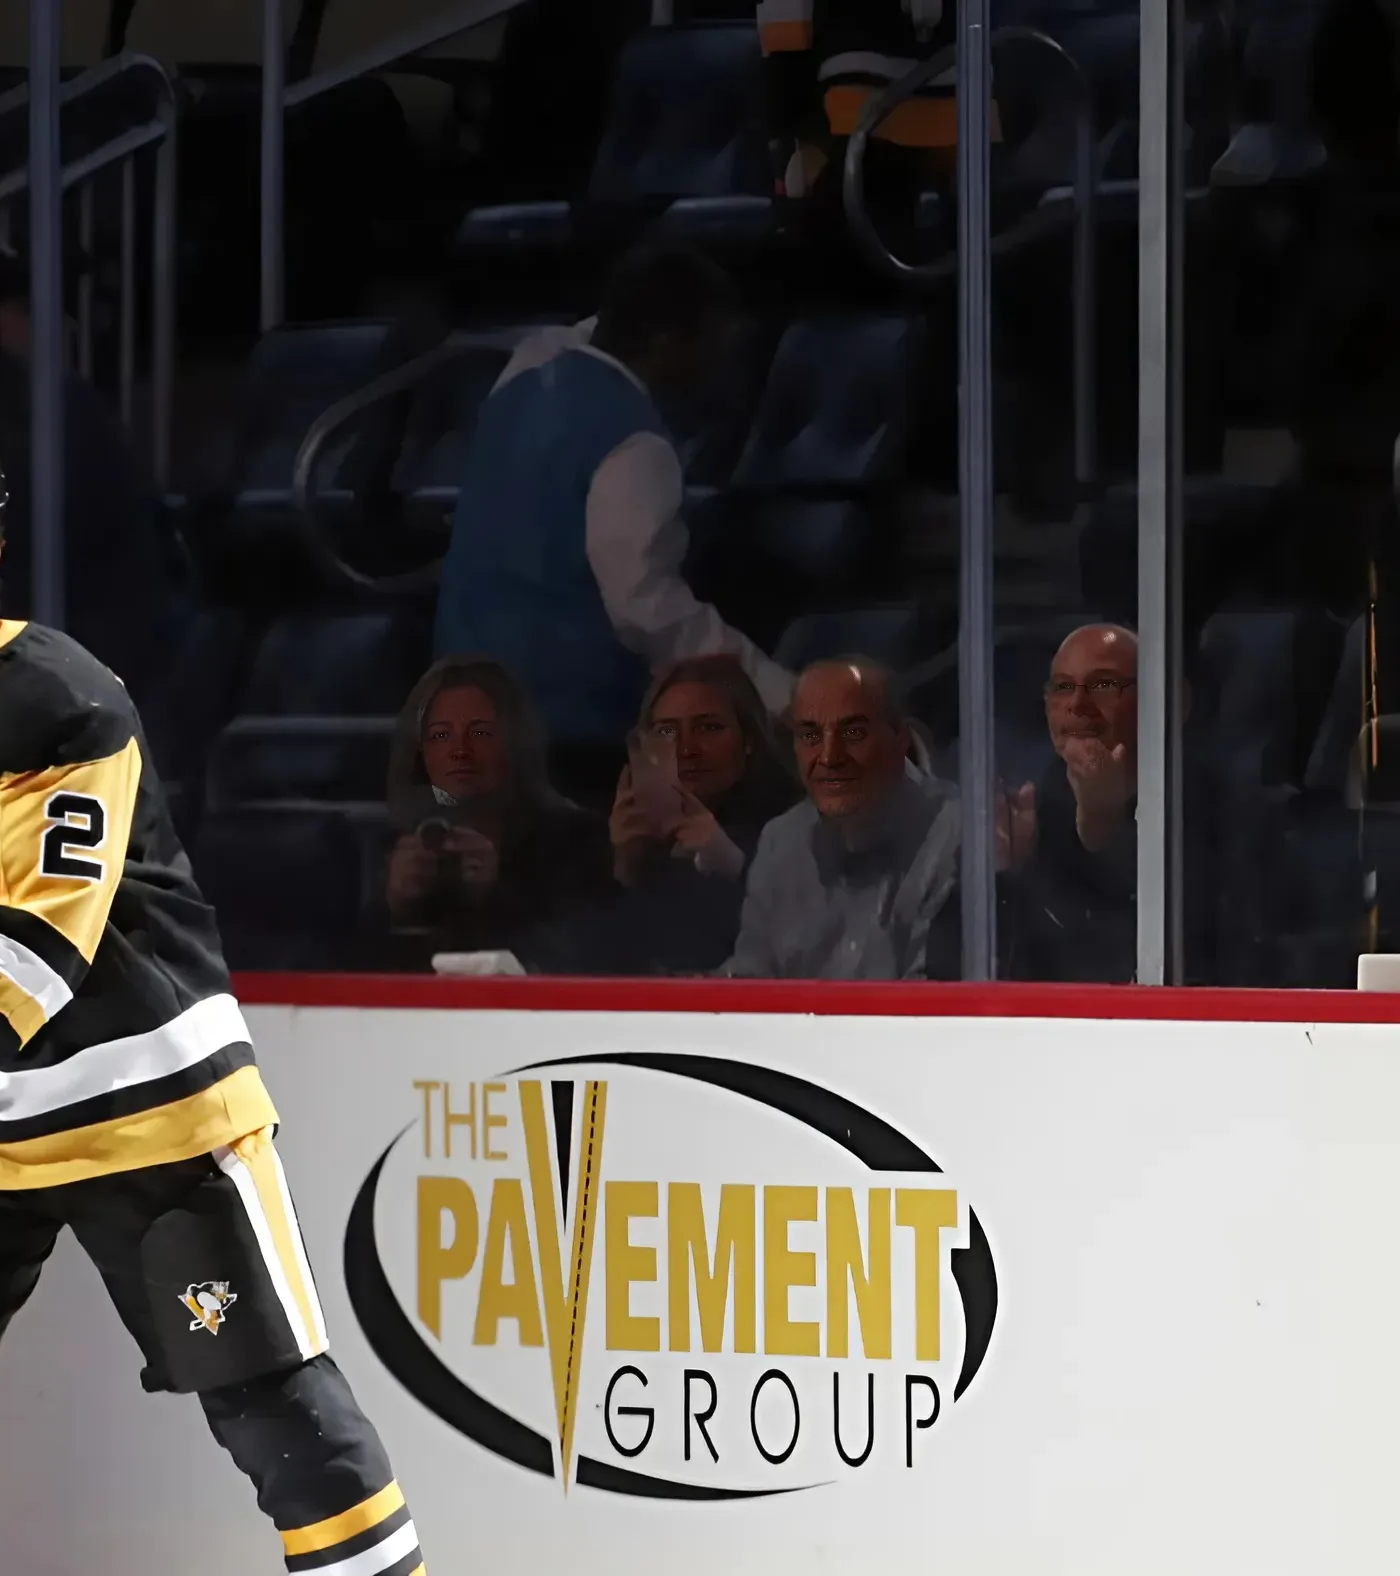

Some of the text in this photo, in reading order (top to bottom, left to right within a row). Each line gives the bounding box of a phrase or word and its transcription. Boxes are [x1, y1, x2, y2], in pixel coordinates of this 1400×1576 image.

[39, 791, 107, 882] 2
[412, 1079, 509, 1161] THE
[603, 1364, 942, 1468] GROUP
